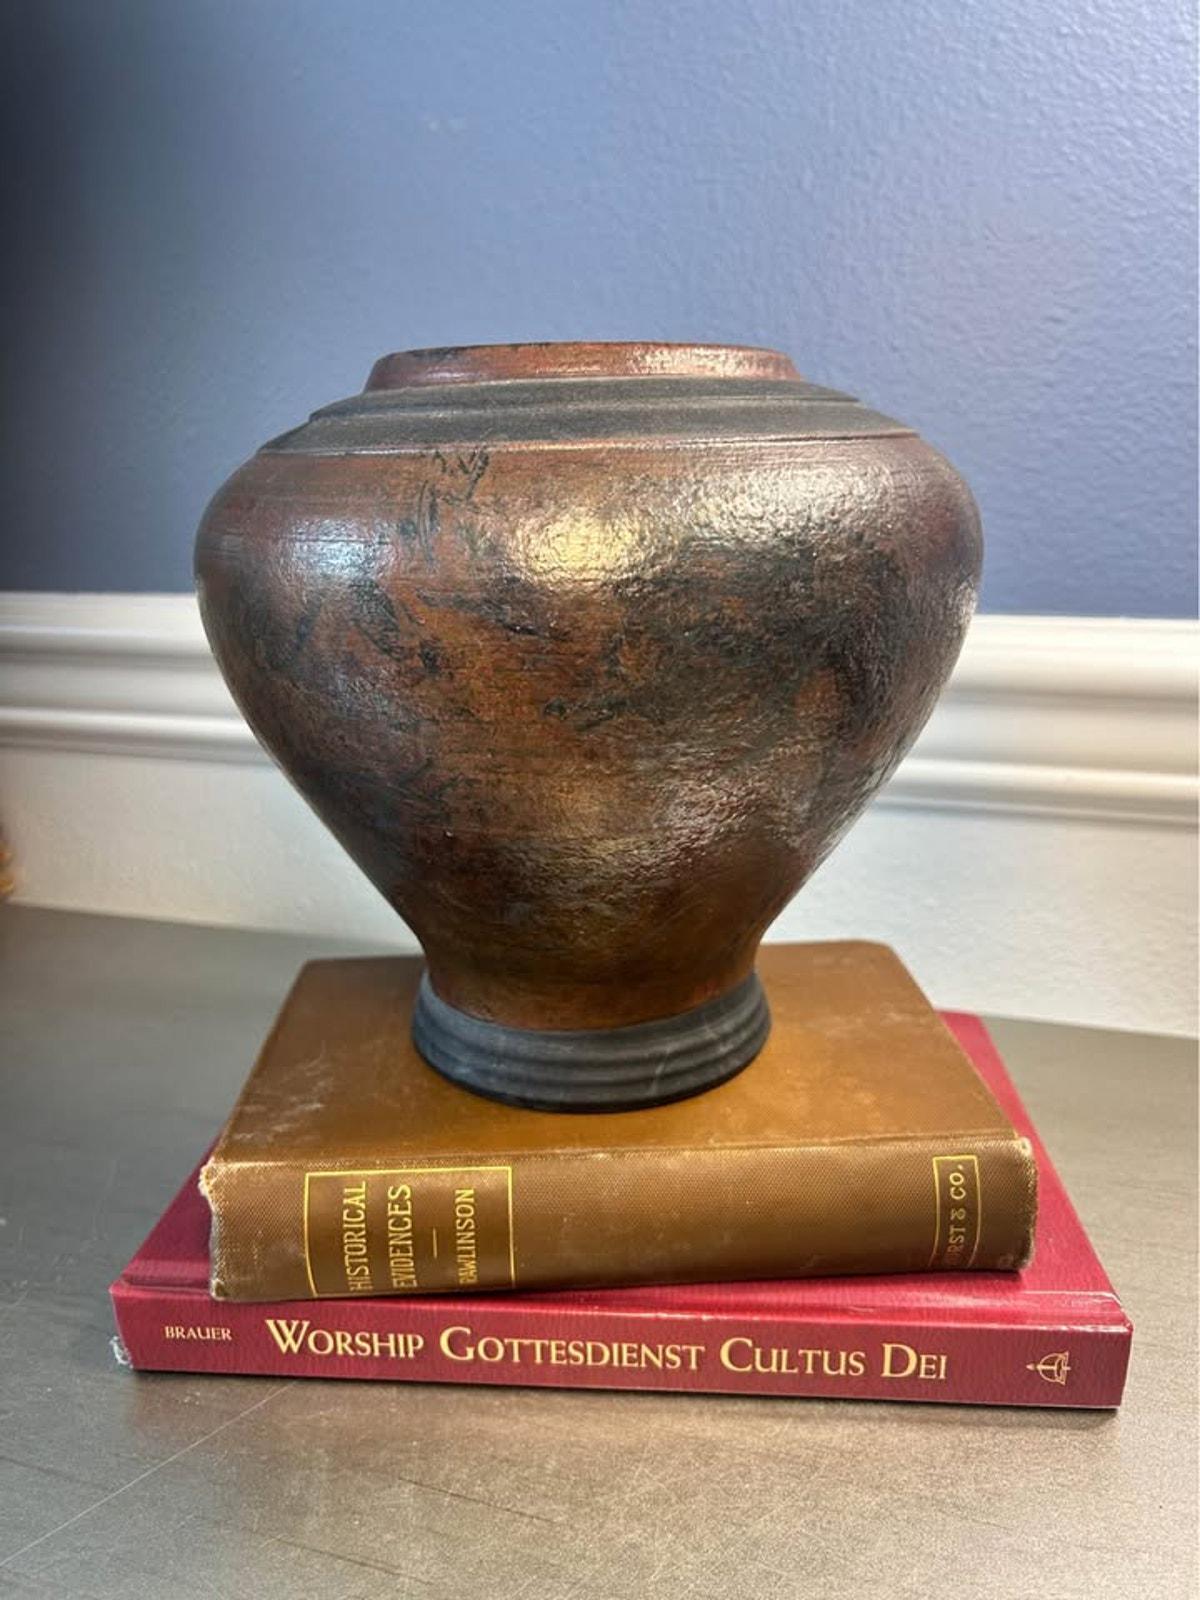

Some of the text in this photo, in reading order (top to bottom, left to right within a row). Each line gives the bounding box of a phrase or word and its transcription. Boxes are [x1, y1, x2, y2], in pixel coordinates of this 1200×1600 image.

[949, 1164, 966, 1200] CO.
[343, 1180, 373, 1292] HISTORICAL
[388, 1183, 418, 1289] EVIDENCES
[950, 1207, 966, 1221] &
[164, 1325, 232, 1341] BRAUER
[265, 1319, 948, 1380] WORSHIP GOTTESDIENST CULTUS DEI
